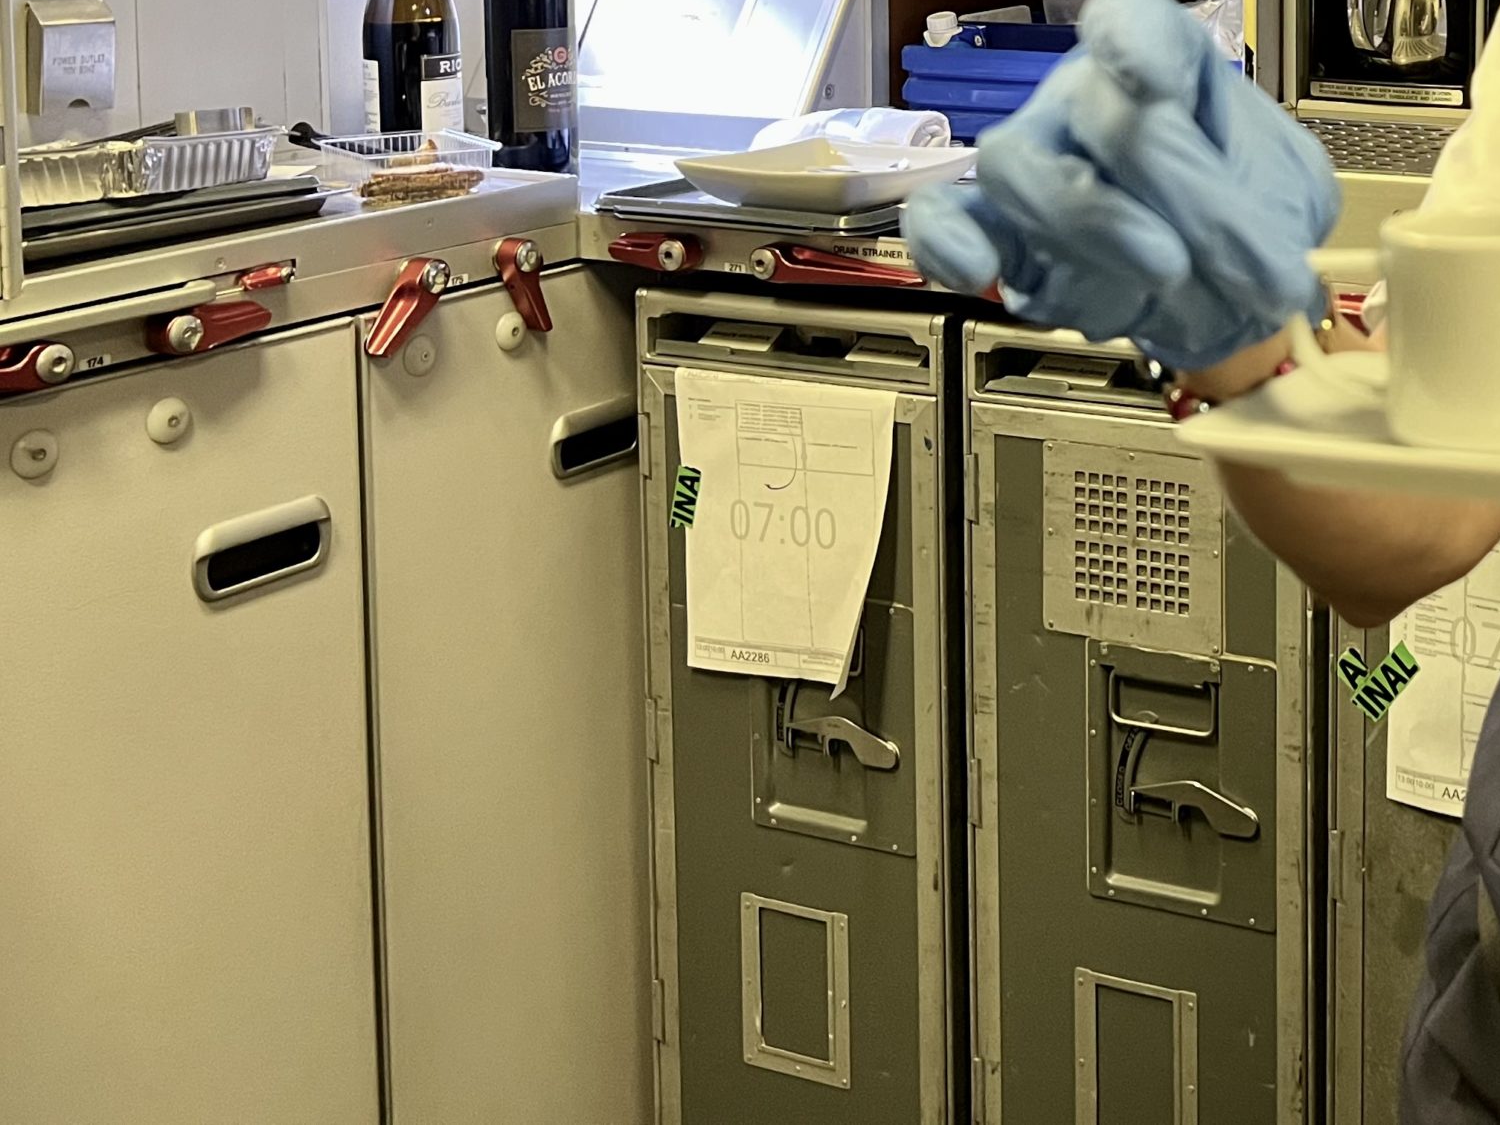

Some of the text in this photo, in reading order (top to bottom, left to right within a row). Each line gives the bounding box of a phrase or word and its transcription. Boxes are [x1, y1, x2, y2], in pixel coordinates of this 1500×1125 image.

[527, 74, 546, 92] EL
[833, 245, 859, 256] DRAIN
[862, 248, 903, 260] STRAINER
[86, 356, 104, 368] 174
[730, 499, 836, 550] 07:00
[730, 649, 770, 665] AA2286
[1352, 651, 1419, 719] INAL
